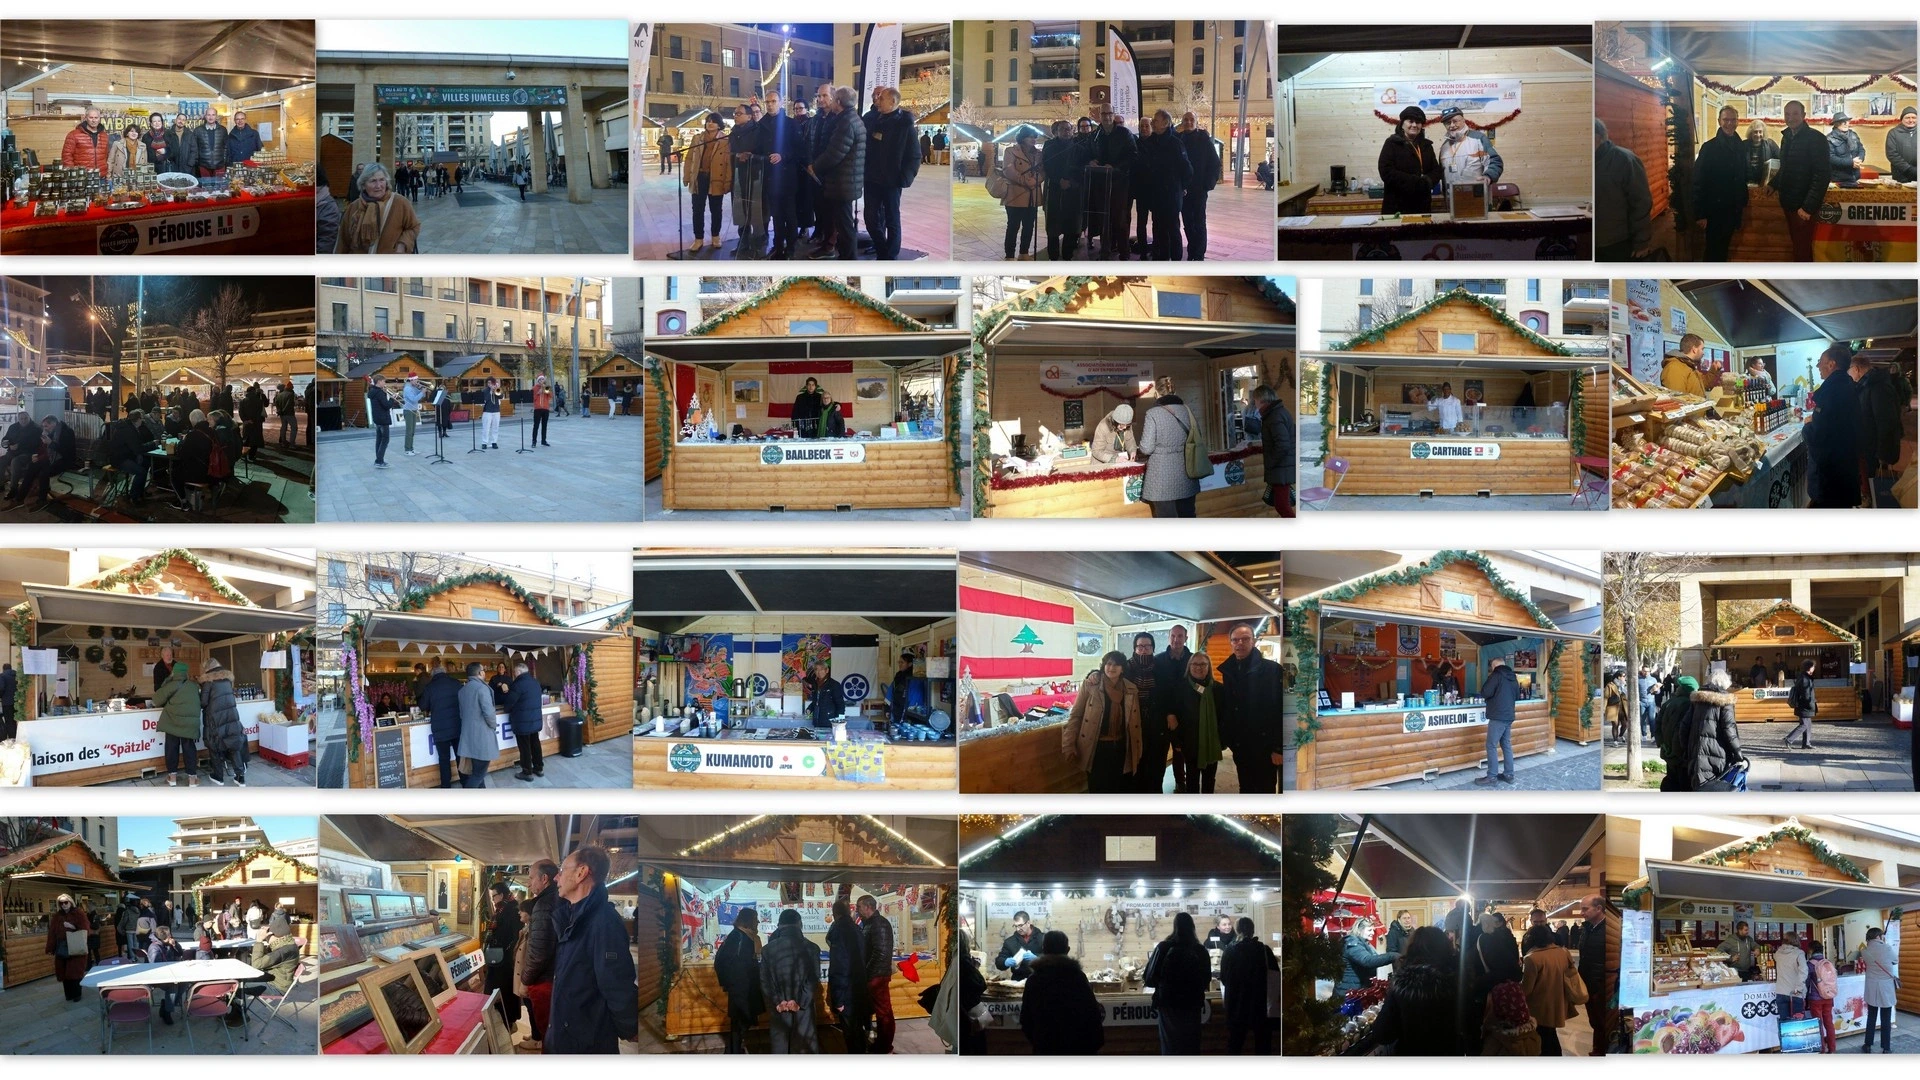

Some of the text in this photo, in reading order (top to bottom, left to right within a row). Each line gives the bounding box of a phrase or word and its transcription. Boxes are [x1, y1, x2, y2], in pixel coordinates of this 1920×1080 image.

[874, 56, 882, 86] umelages
[442, 93, 510, 103] VILLES JUMELLES
[1848, 205, 1907, 221] GRENADE
[148, 219, 234, 245] PÉROUSE ITALIE
[785, 449, 831, 460] BAALBECK
[1432, 446, 1472, 456] CARTHAGE
[1428, 713, 1467, 727] ASHKELON
[31, 751, 74, 766] aison
[78, 747, 100, 760] des
[705, 753, 774, 769] KUMAMOTO
[450, 957, 472, 979] PÉROUSE
[1744, 991, 1777, 1001] DOMAIN
[1113, 1002, 1159, 1021] PÉROUS
